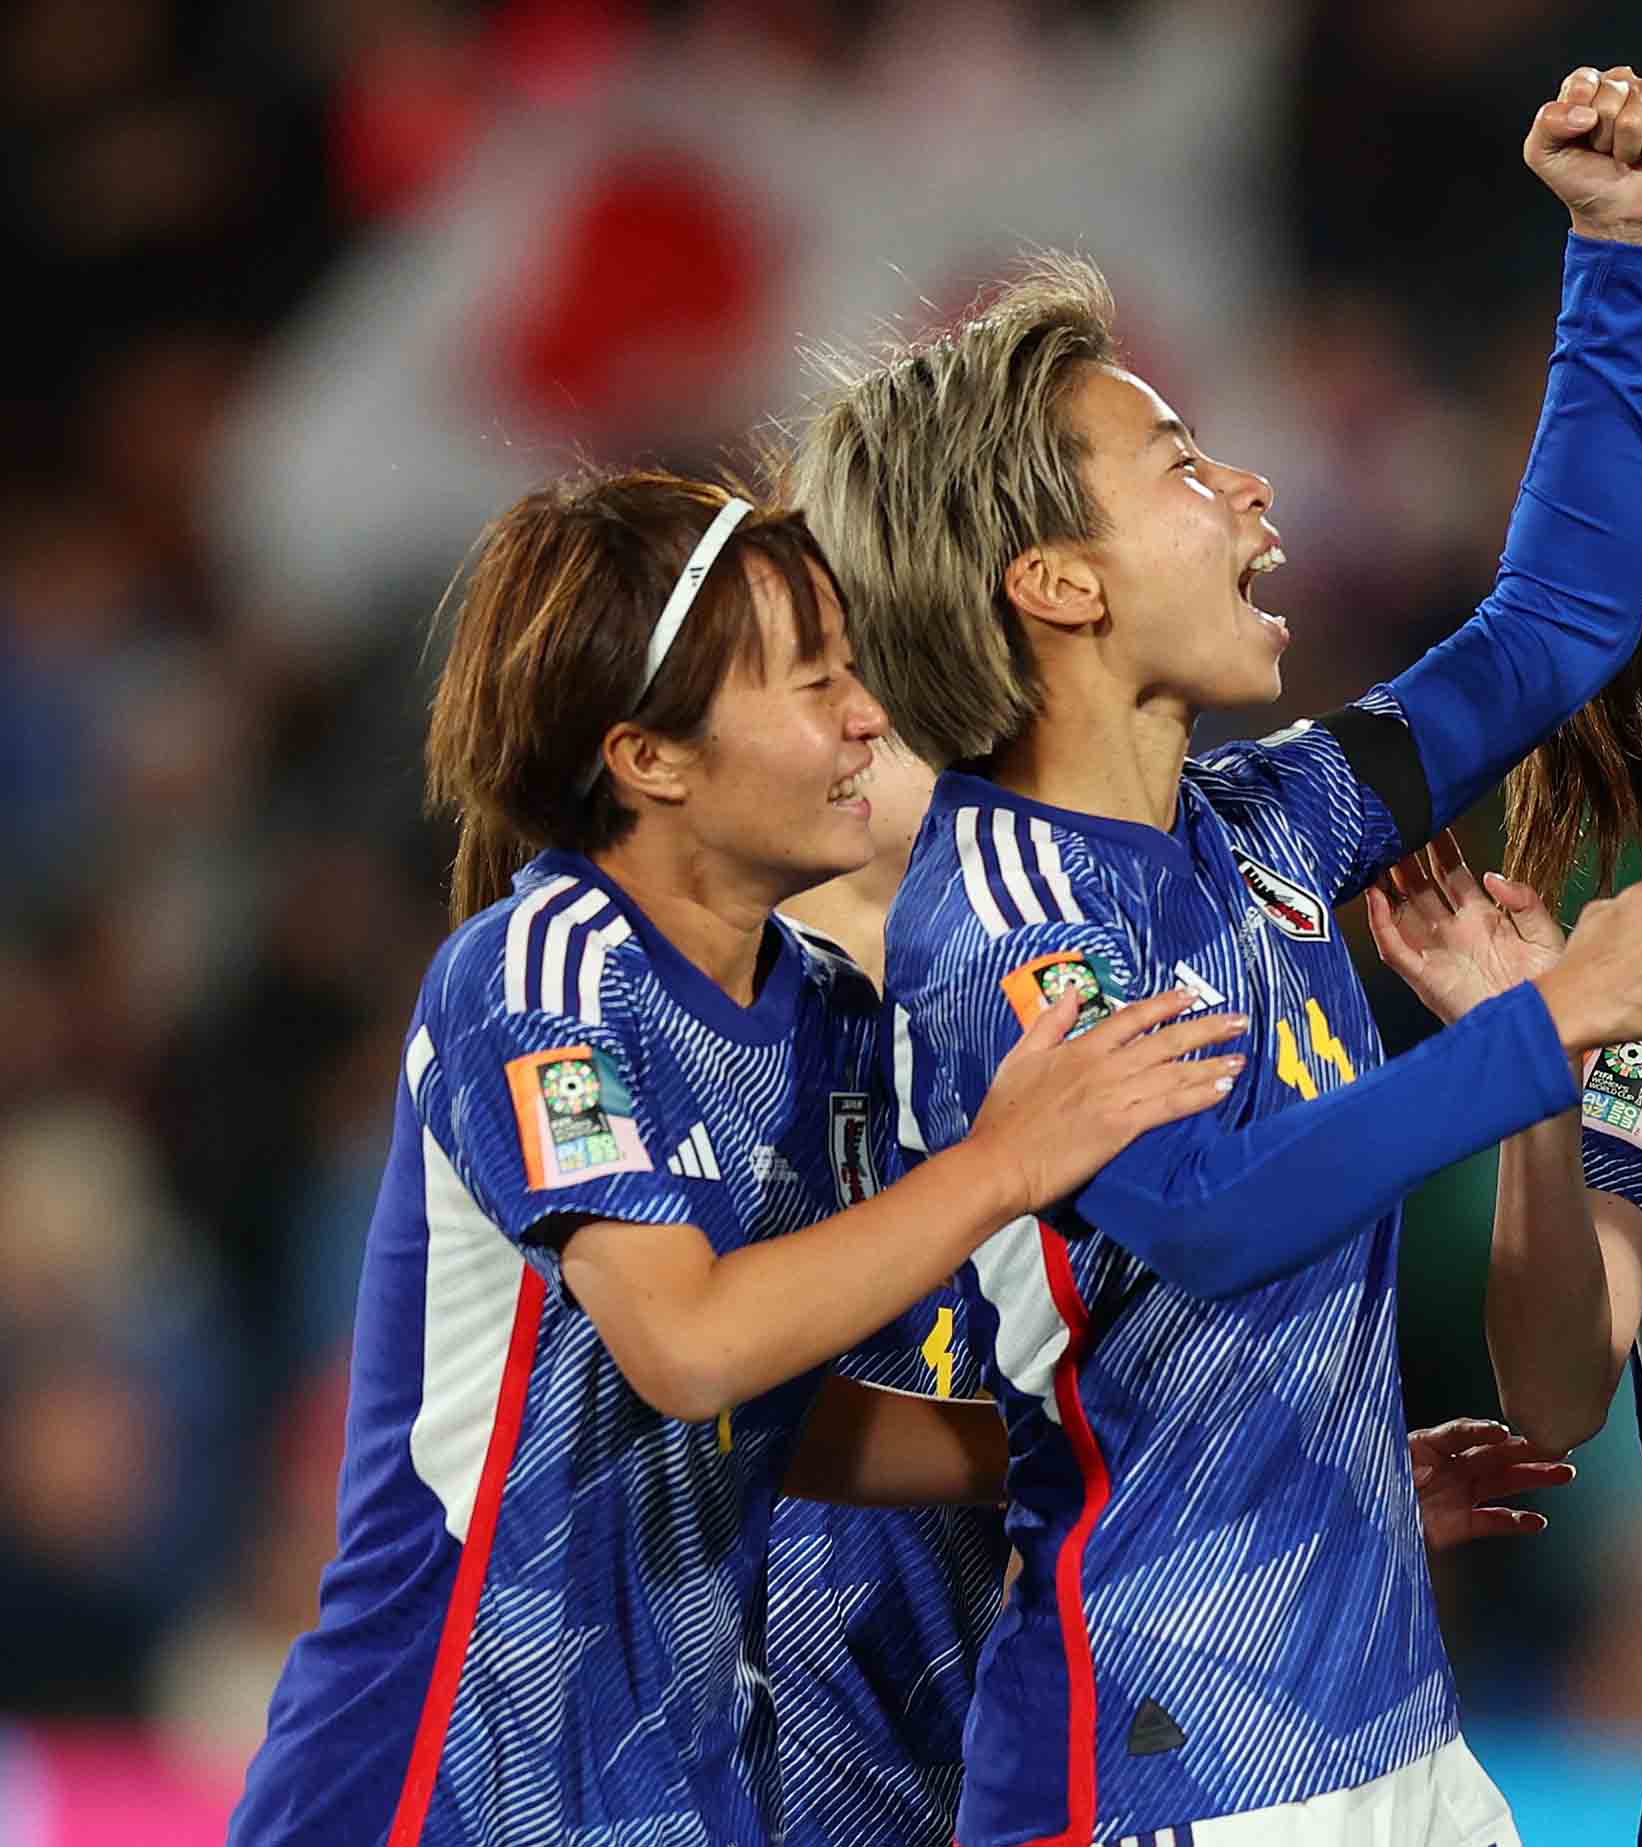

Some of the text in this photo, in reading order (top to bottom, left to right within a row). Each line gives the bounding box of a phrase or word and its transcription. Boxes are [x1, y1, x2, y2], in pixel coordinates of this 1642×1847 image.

[1592, 1070, 1613, 1080] FIFA
[1589, 1081, 1634, 1101] WORLD CUP
